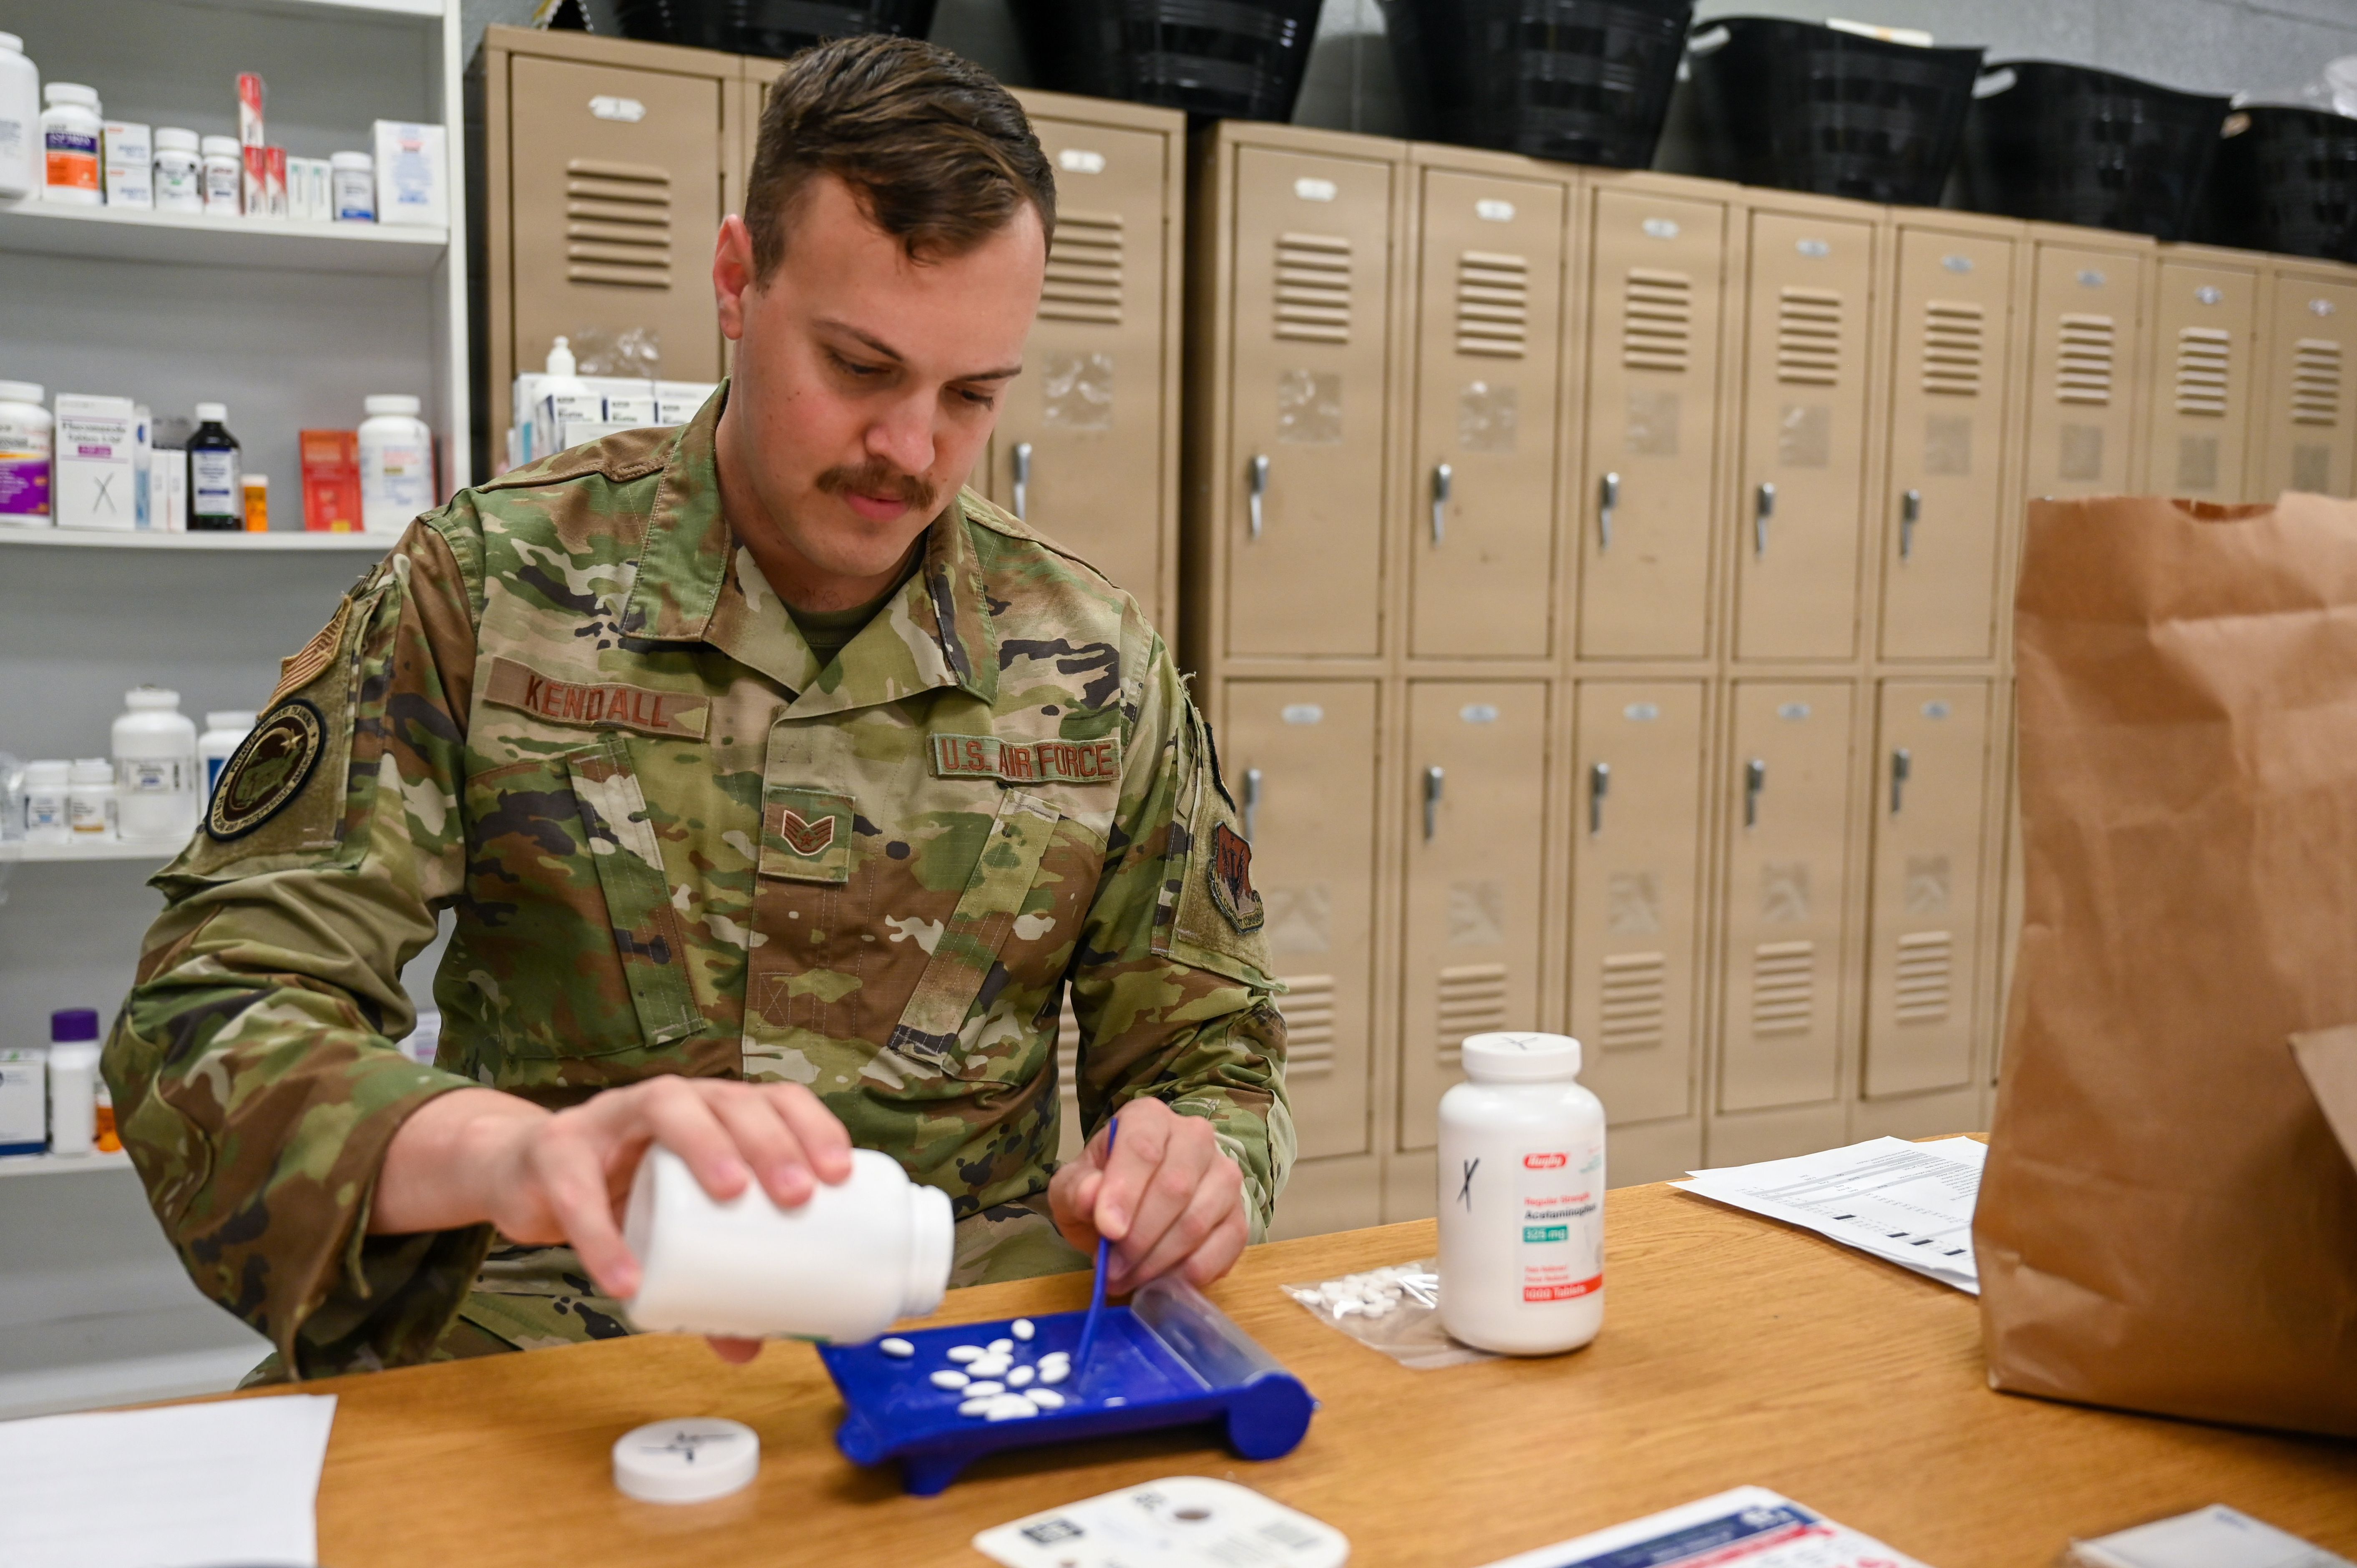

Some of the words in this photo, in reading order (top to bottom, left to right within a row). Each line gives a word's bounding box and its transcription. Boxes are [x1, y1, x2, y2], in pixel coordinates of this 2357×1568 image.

[524, 674, 669, 728] KENDALL
[941, 738, 992, 771] U.S.
[999, 744, 1032, 777] AIR
[1036, 744, 1113, 777] FORCE
[1548, 1229, 1565, 1241] mg
[1525, 1287, 1551, 1300] 1000
[1554, 1284, 1586, 1298] Tablets
